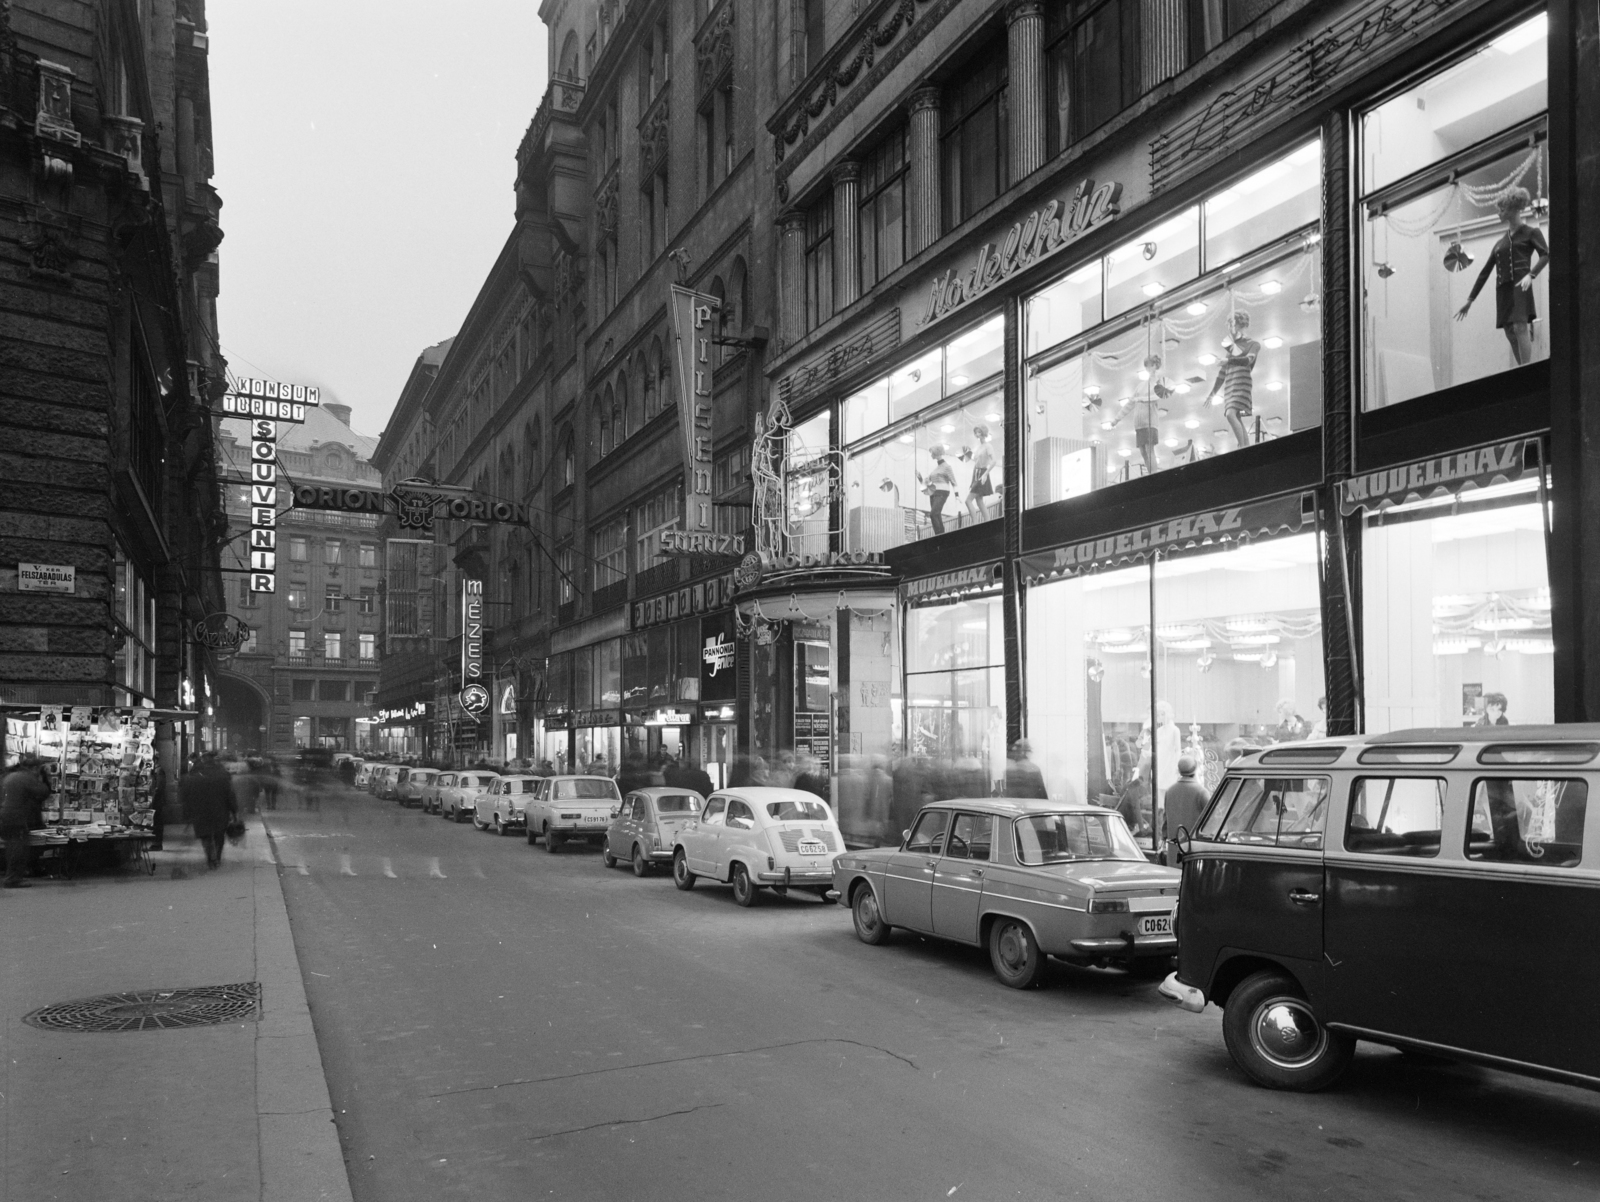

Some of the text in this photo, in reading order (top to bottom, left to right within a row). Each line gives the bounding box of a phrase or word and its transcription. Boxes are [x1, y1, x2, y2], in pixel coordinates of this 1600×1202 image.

[240, 378, 317, 401] KONSUM
[226, 397, 303, 418] TURIST
[695, 305, 711, 528] PILSENI
[256, 420, 272, 592] SOUVENIR
[296, 485, 384, 511] ORION
[450, 499, 528, 522] ORION
[704, 644, 734, 658] PANNONIA
